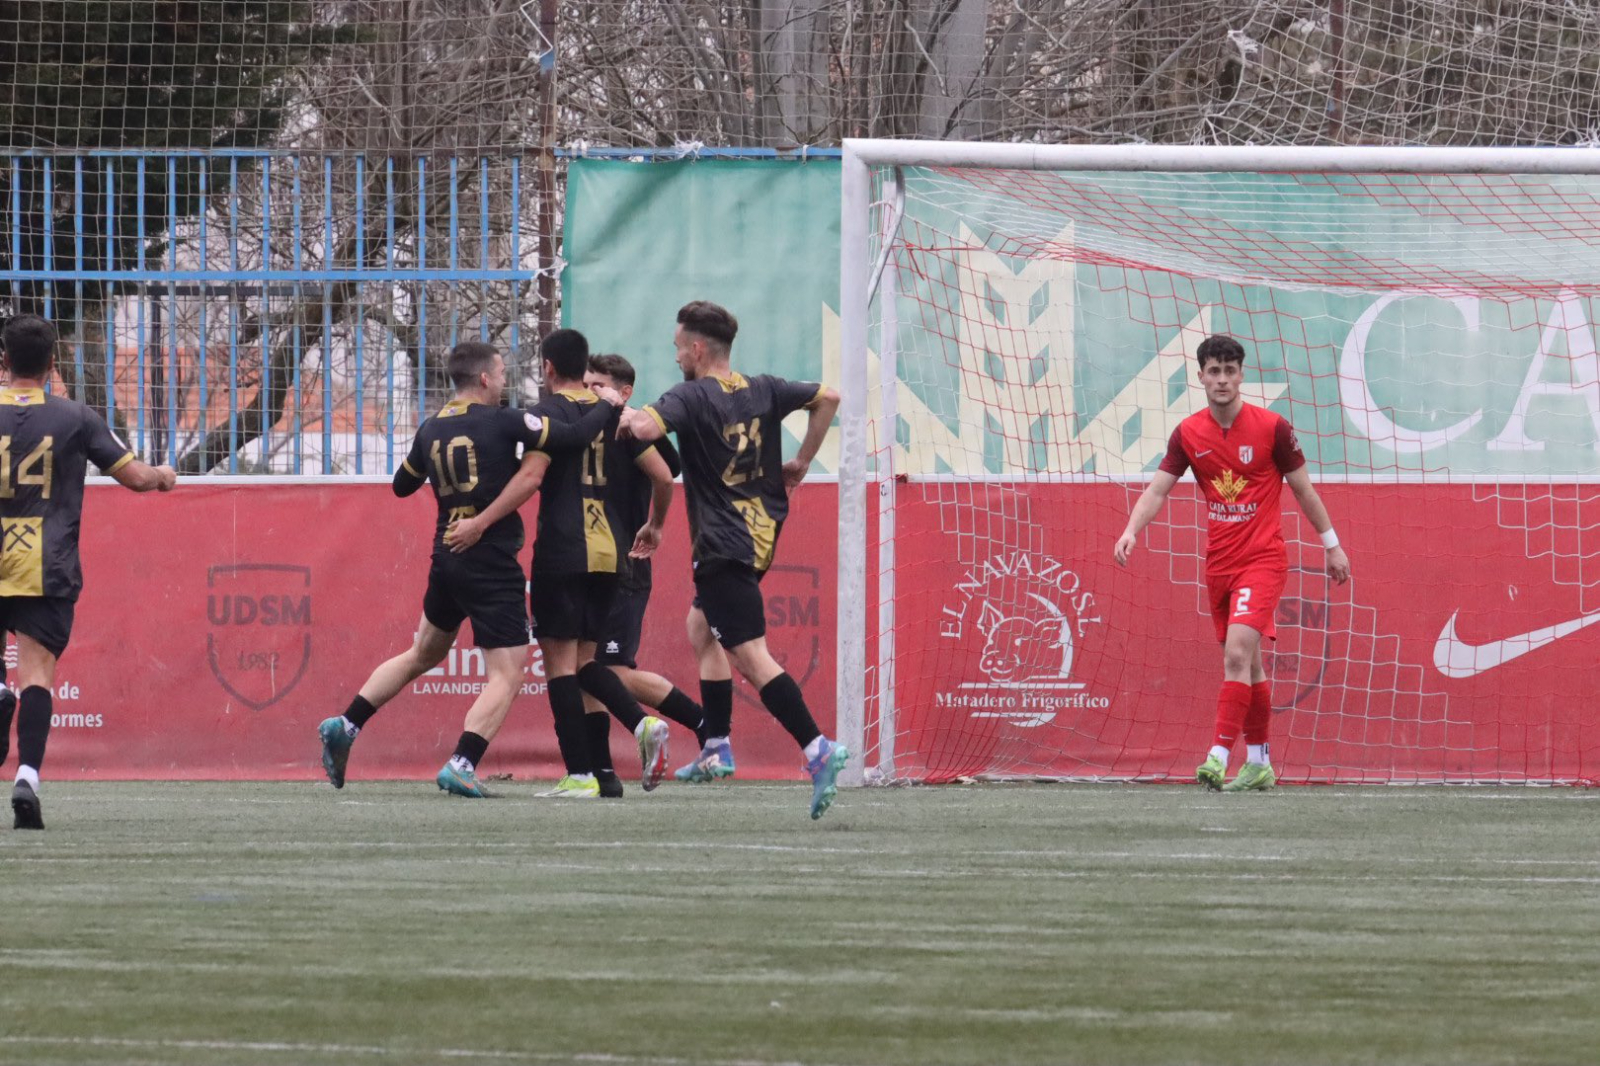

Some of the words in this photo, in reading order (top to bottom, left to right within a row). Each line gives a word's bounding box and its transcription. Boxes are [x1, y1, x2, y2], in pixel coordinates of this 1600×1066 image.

[0, 435, 53, 499] 14
[430, 435, 479, 497] 10
[722, 417, 764, 487] 21
[953, 552, 1080, 600] NAVAZO
[207, 594, 311, 625] UDSM
[767, 595, 819, 627] SM
[1237, 587, 1251, 612] 2
[58, 681, 79, 700] de
[935, 692, 1016, 708] Matadero
[50, 713, 103, 727] ormes
